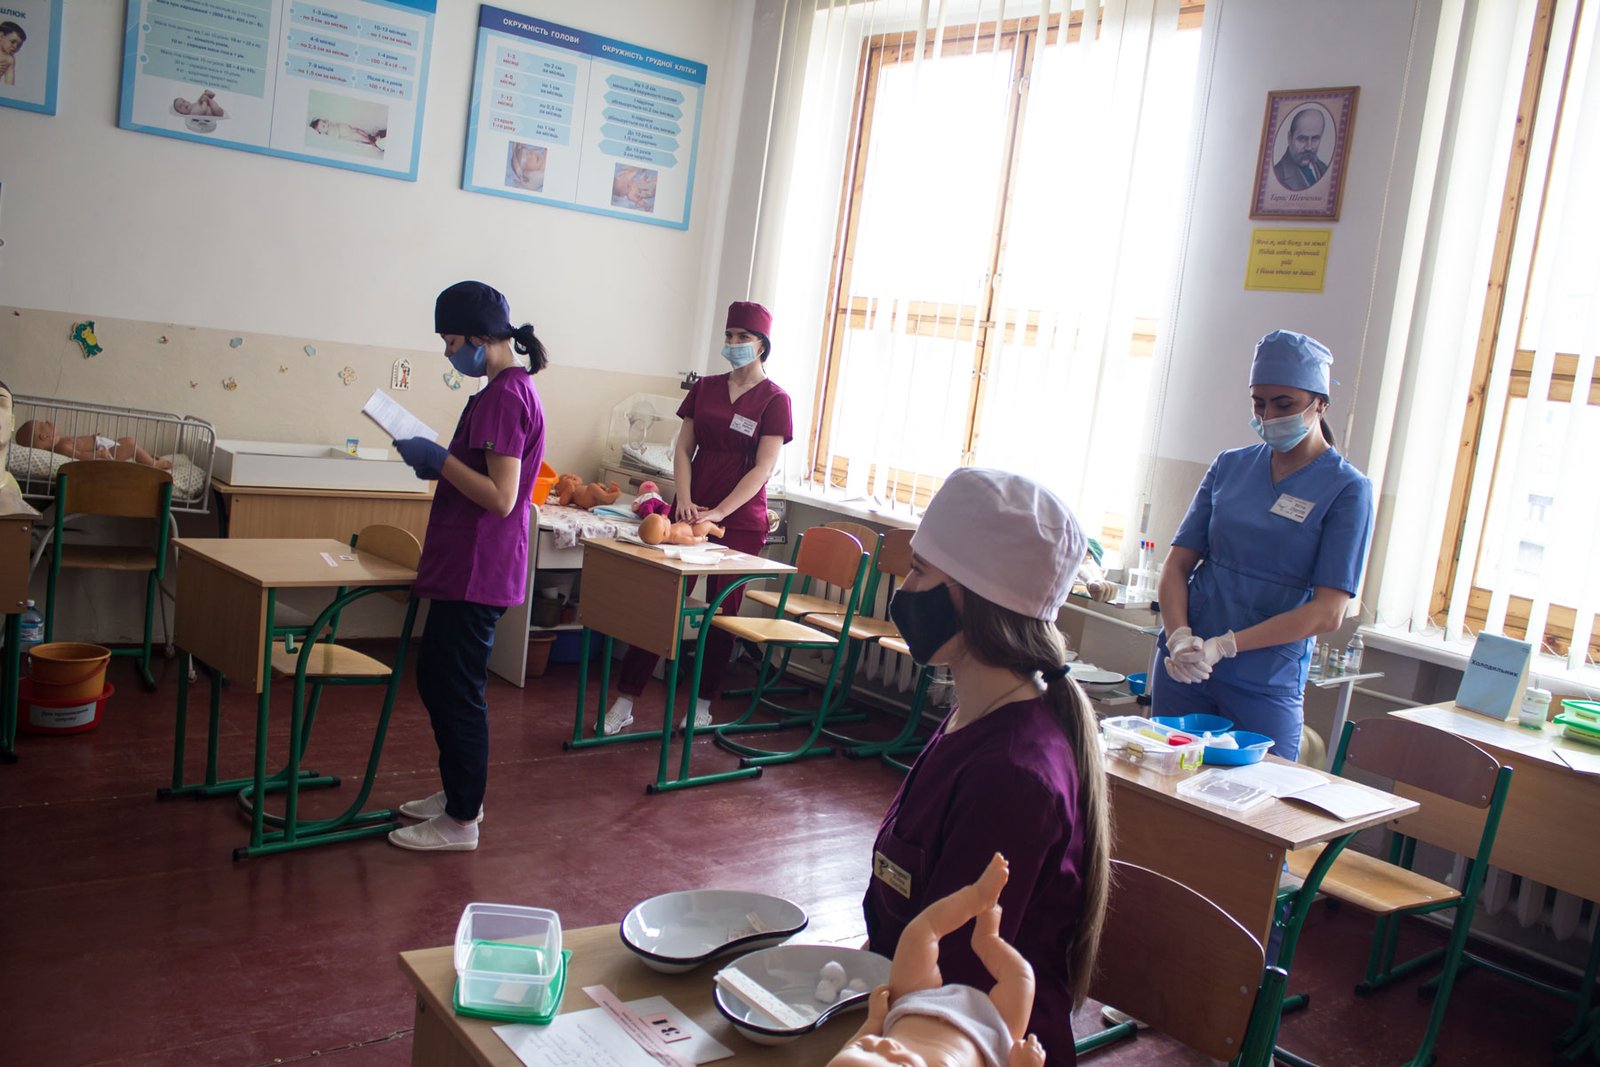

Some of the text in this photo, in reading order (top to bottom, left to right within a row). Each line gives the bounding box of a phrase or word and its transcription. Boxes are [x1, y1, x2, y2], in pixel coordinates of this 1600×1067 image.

[503, 18, 579, 44] ОКРУЖНІСТЬ ГОЛОВИ
[602, 45, 697, 75] ОКРУЖНІСТЬ ГРУДНОЇ КЛІТКИ
[1471, 659, 1519, 678] Холодильник
